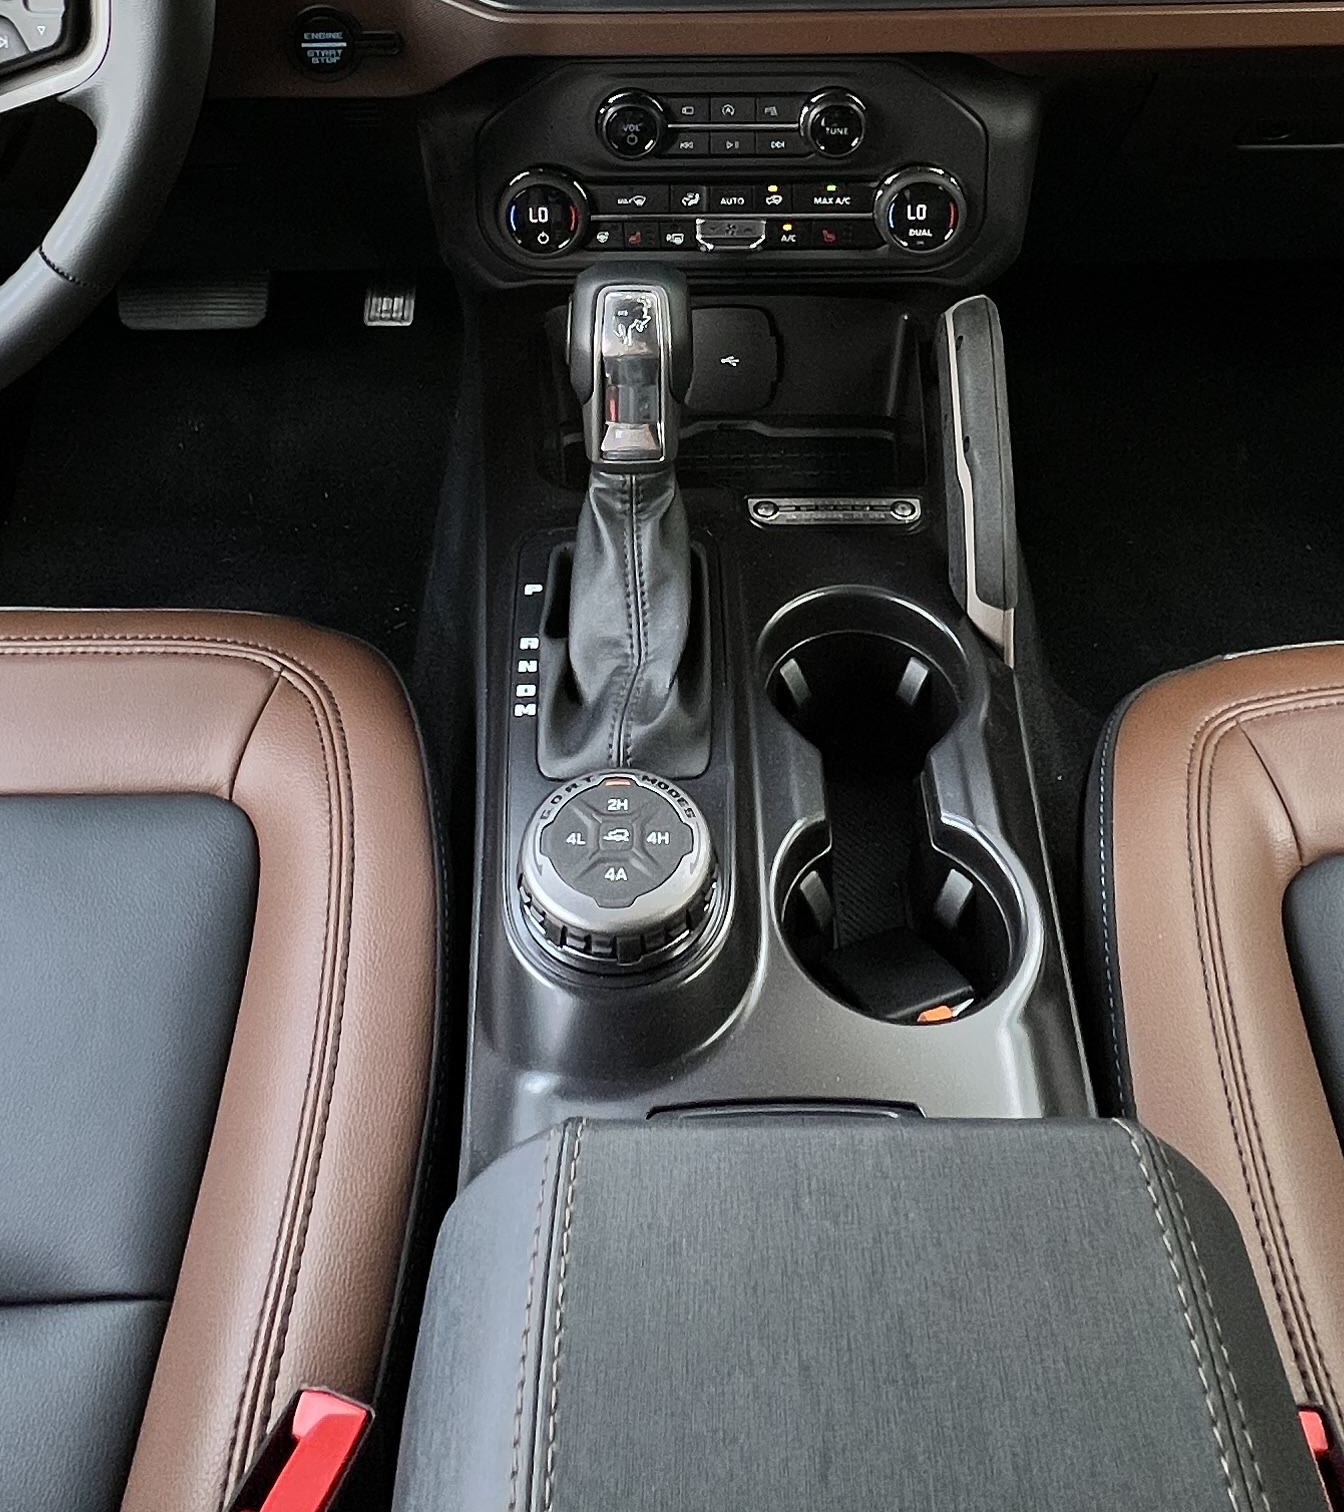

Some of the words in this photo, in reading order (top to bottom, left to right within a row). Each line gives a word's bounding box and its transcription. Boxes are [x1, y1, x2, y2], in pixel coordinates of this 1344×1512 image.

[303, 31, 343, 40] ENGINE
[307, 49, 343, 57] START
[623, 124, 640, 133] VOL
[826, 126, 849, 136] TUNE
[720, 197, 746, 206] AUTO
[813, 196, 834, 205] MAX
[834, 196, 851, 206] A/C
[528, 206, 549, 223] LO
[906, 203, 927, 221] LO
[780, 234, 797, 243] A/C
[908, 228, 933, 238] DUAL
[524, 583, 544, 596] P
[519, 637, 540, 650] R
[517, 660, 538, 673] N
[515, 684, 537, 697] D
[514, 703, 537, 717] M
[641, 775, 697, 820] MODES
[607, 798, 629, 812] 2H
[566, 832, 587, 846] 4L
[646, 831, 671, 846] 4H
[604, 867, 629, 882] 4A
